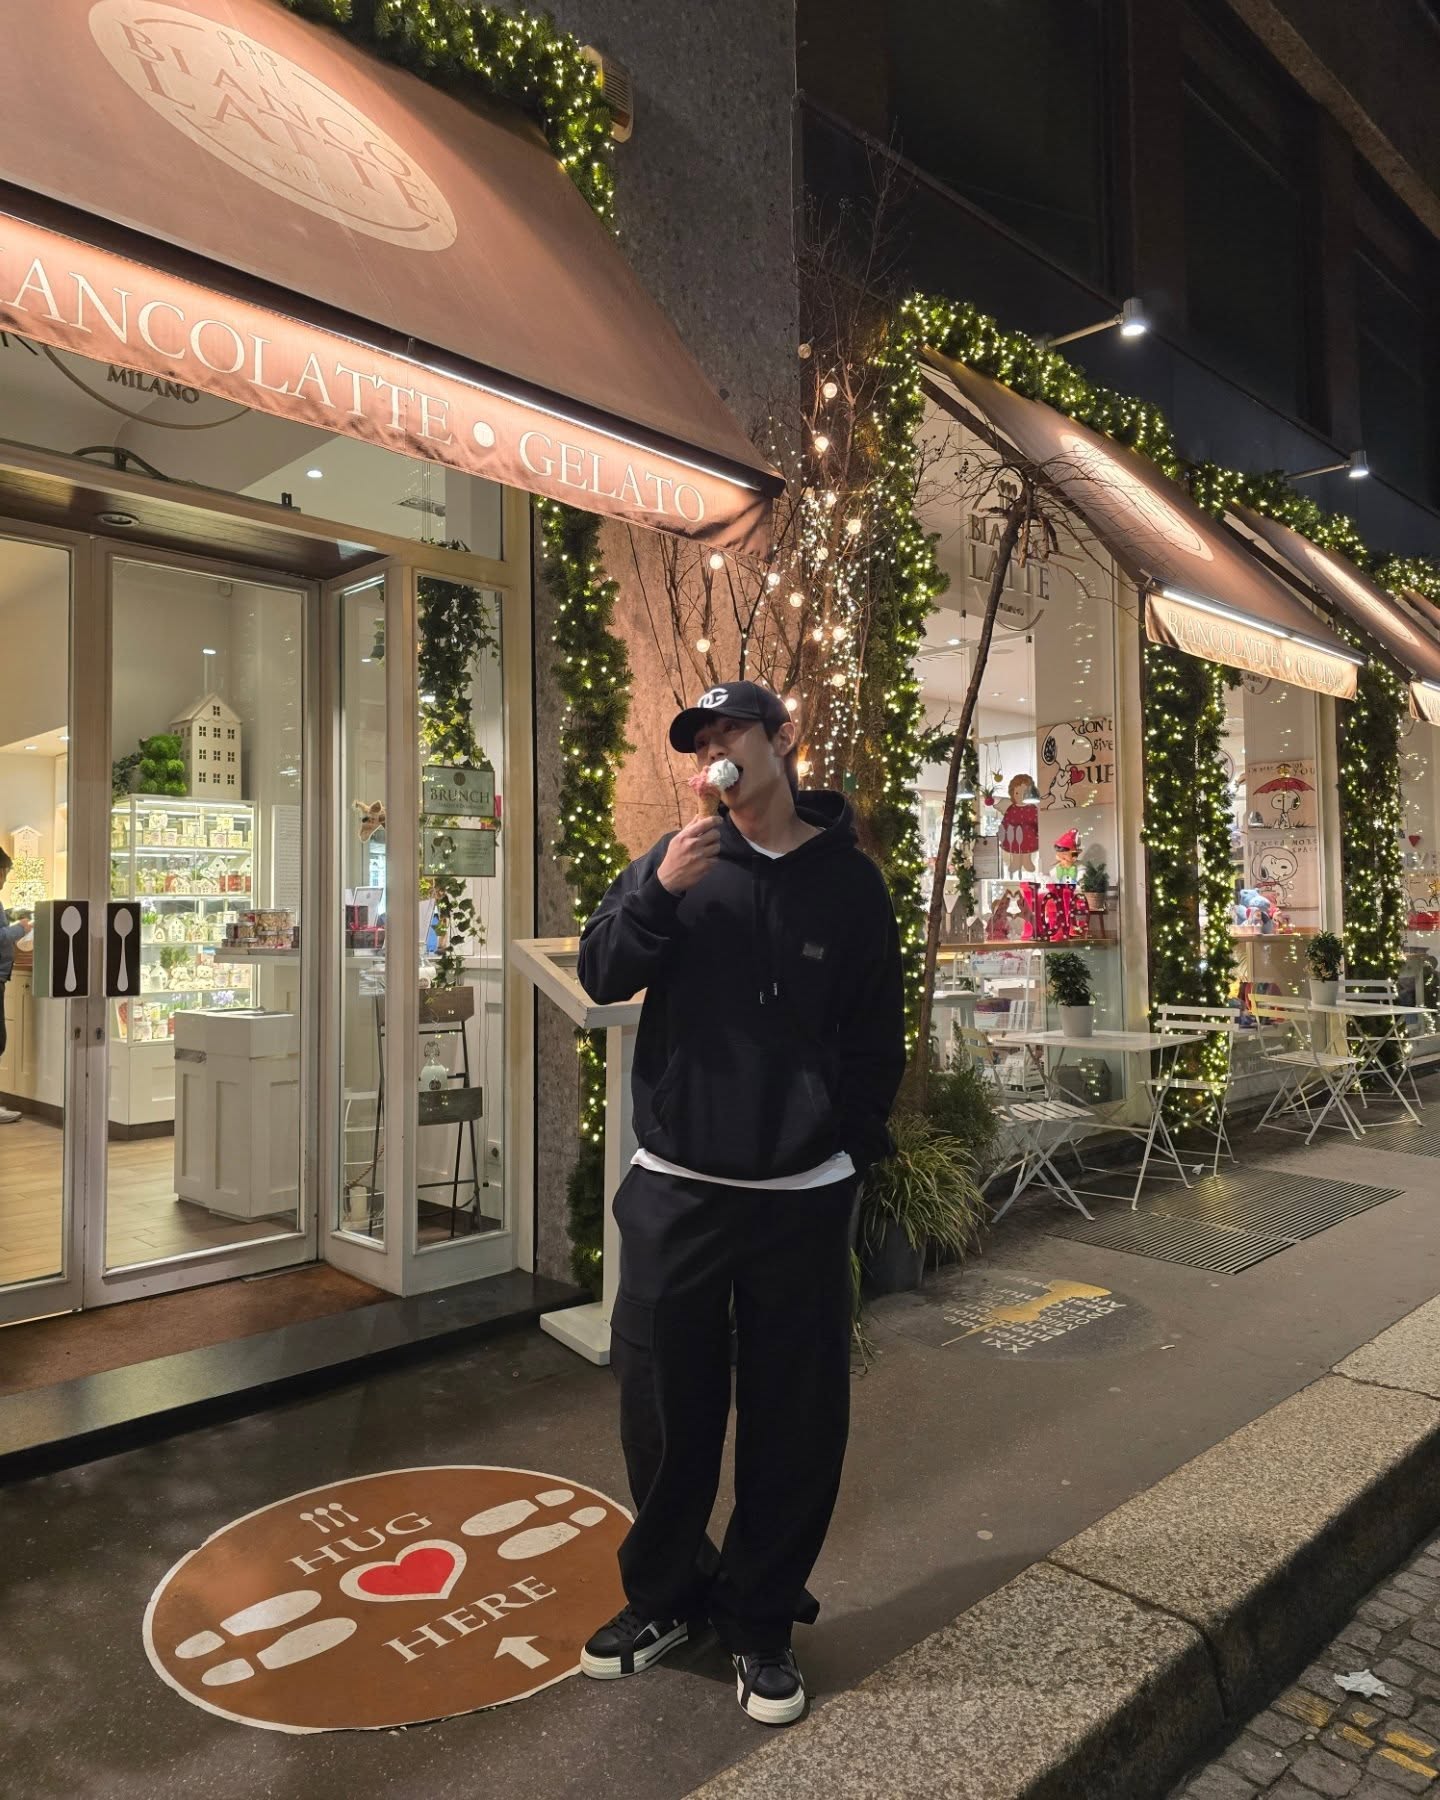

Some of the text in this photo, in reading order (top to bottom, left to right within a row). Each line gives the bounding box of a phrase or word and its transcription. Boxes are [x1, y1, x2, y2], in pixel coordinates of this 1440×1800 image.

[118, 20, 412, 177] BIANCO
[134, 60, 440, 226] LATTE
[0, 246, 705, 523] ANCOLATTE GELATO
[107, 364, 199, 404] MILANO
[1167, 611, 1281, 670] BIANCOLATTE
[430, 788, 489, 803] BRUNCH
[981, 1338, 1028, 1354] XXI
[284, 1511, 433, 1577] HUG
[382, 1576, 558, 1664] HERE
